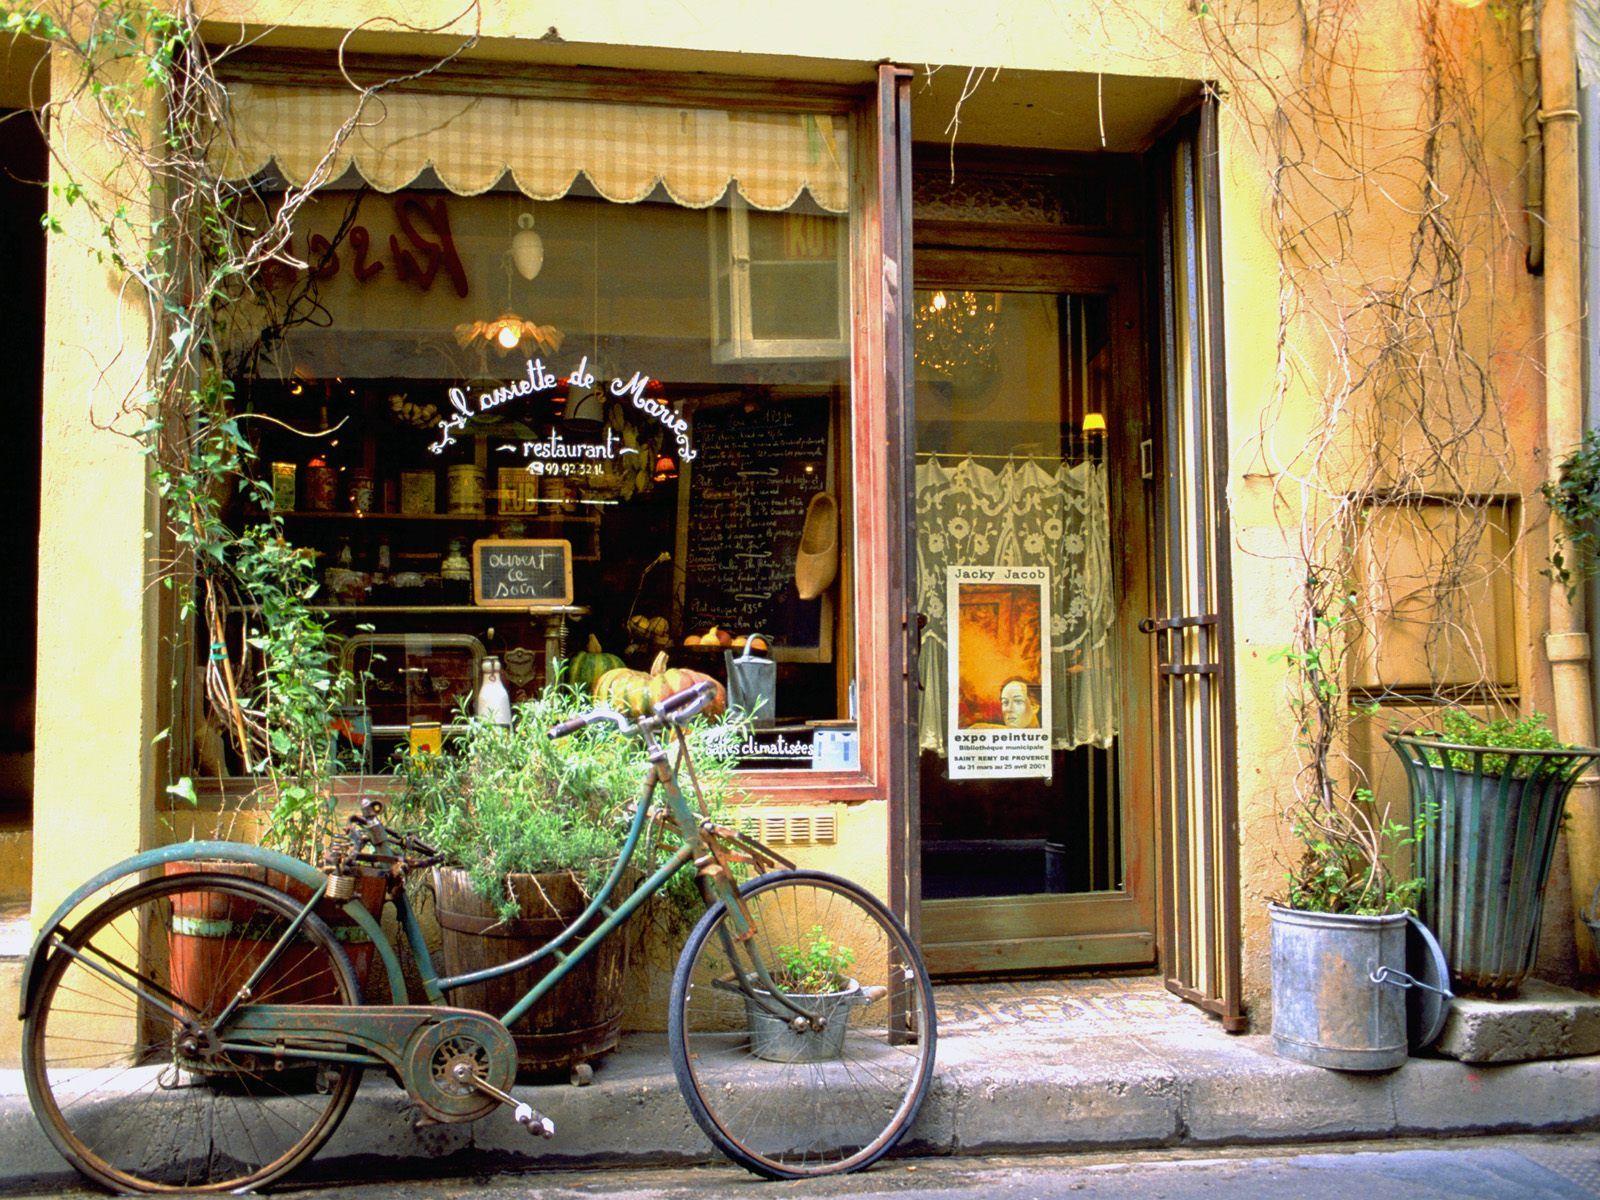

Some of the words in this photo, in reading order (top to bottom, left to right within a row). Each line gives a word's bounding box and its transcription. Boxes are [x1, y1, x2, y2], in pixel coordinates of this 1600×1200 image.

[449, 358, 556, 416] l'assiette
[567, 355, 595, 389] de
[610, 371, 689, 436] Marie
[523, 427, 619, 459] restaurant
[489, 549, 559, 571] ouvert
[507, 568, 528, 582] ce
[955, 569, 995, 582] Jacky
[1004, 569, 1046, 580] Jacob
[741, 734, 814, 756] climatisées
[954, 734, 987, 743] expo
[992, 732, 1049, 743] peinture
